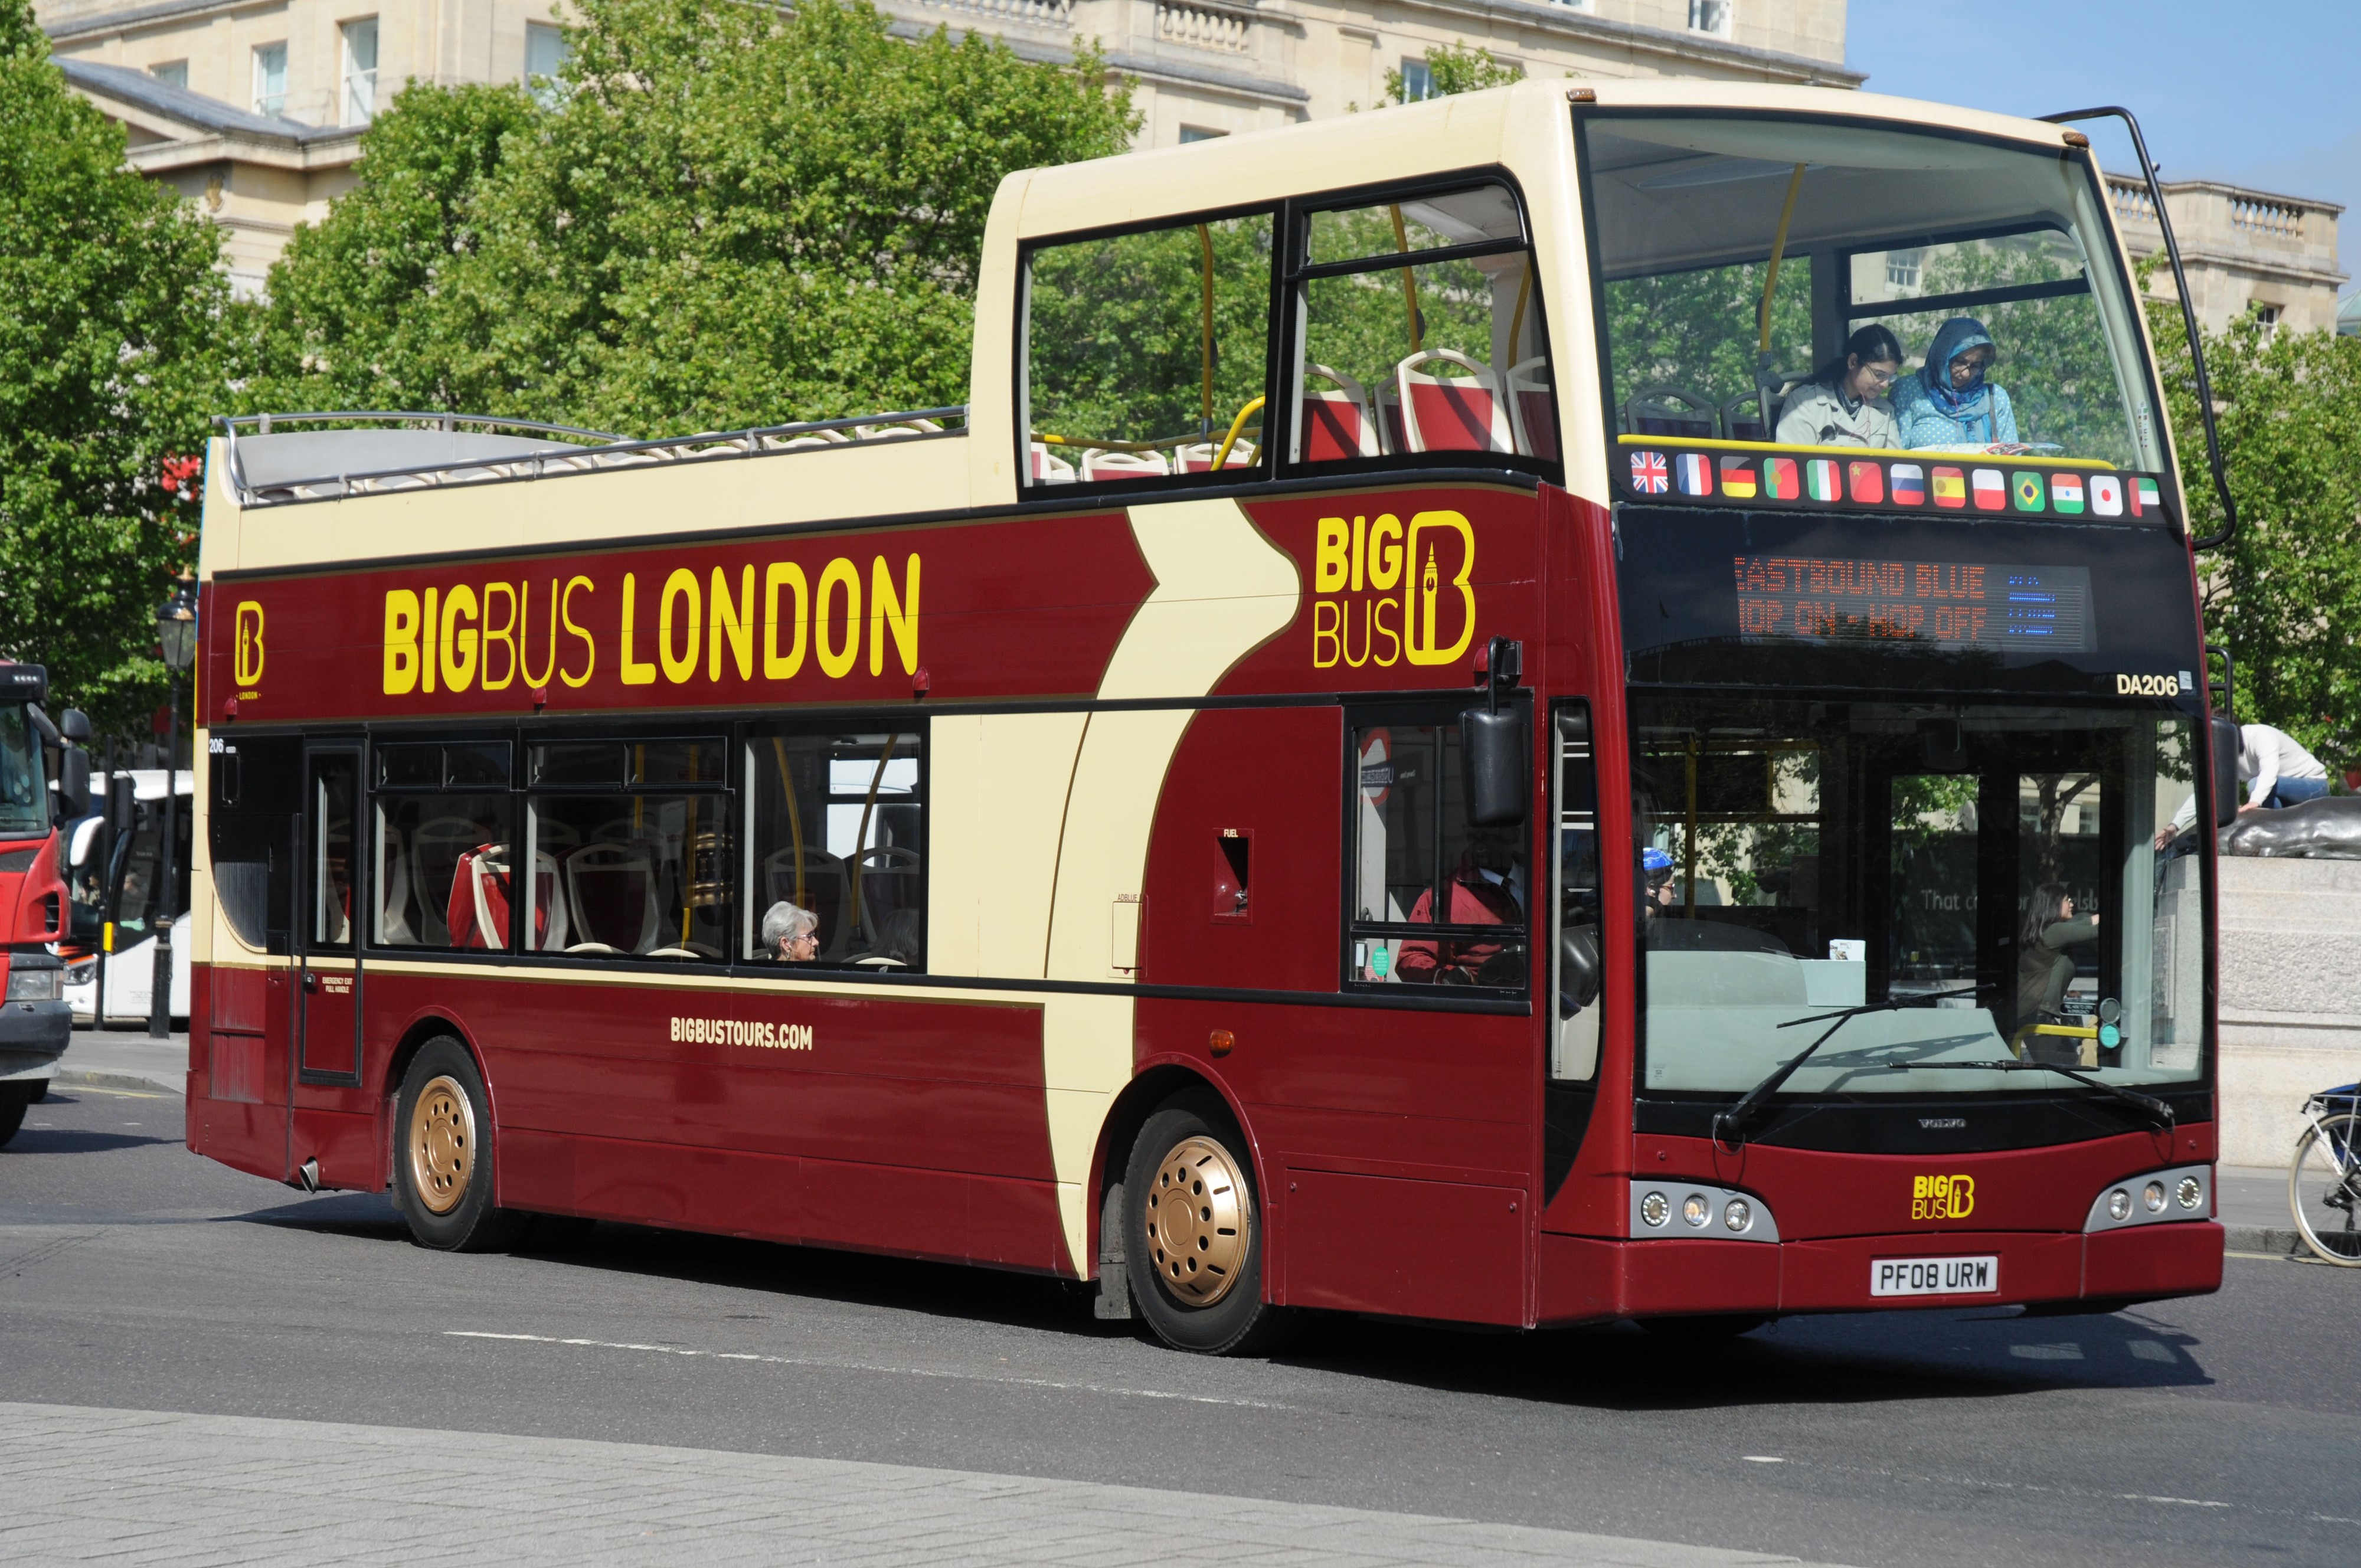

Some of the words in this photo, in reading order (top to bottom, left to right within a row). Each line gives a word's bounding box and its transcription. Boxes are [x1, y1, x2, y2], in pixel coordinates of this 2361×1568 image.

[1316, 512, 1403, 593] BIG
[1916, 564, 1986, 599] BLUE
[620, 552, 921, 685] LONDON
[1795, 601, 1836, 635] ON
[1869, 603, 1925, 638] HOP
[1935, 605, 1987, 640] OFF
[1313, 597, 1401, 668] BUS
[239, 692, 258, 700] LONDON
[2117, 674, 2179, 696] DA206
[209, 738, 224, 754] 206
[1224, 829, 1238, 837] FUEL
[1117, 893, 1138, 902] ADBLUE
[1921, 889, 1961, 911] That
[671, 1017, 813, 1050] BIGBUSTOURS.COM
[1918, 1118, 1967, 1128] VOLVO
[1913, 1175, 1948, 1199] BIG
[1911, 1199, 1947, 1220] BUS
[1881, 1263, 1939, 1289] PF08
[1946, 1262, 1988, 1288] URW
